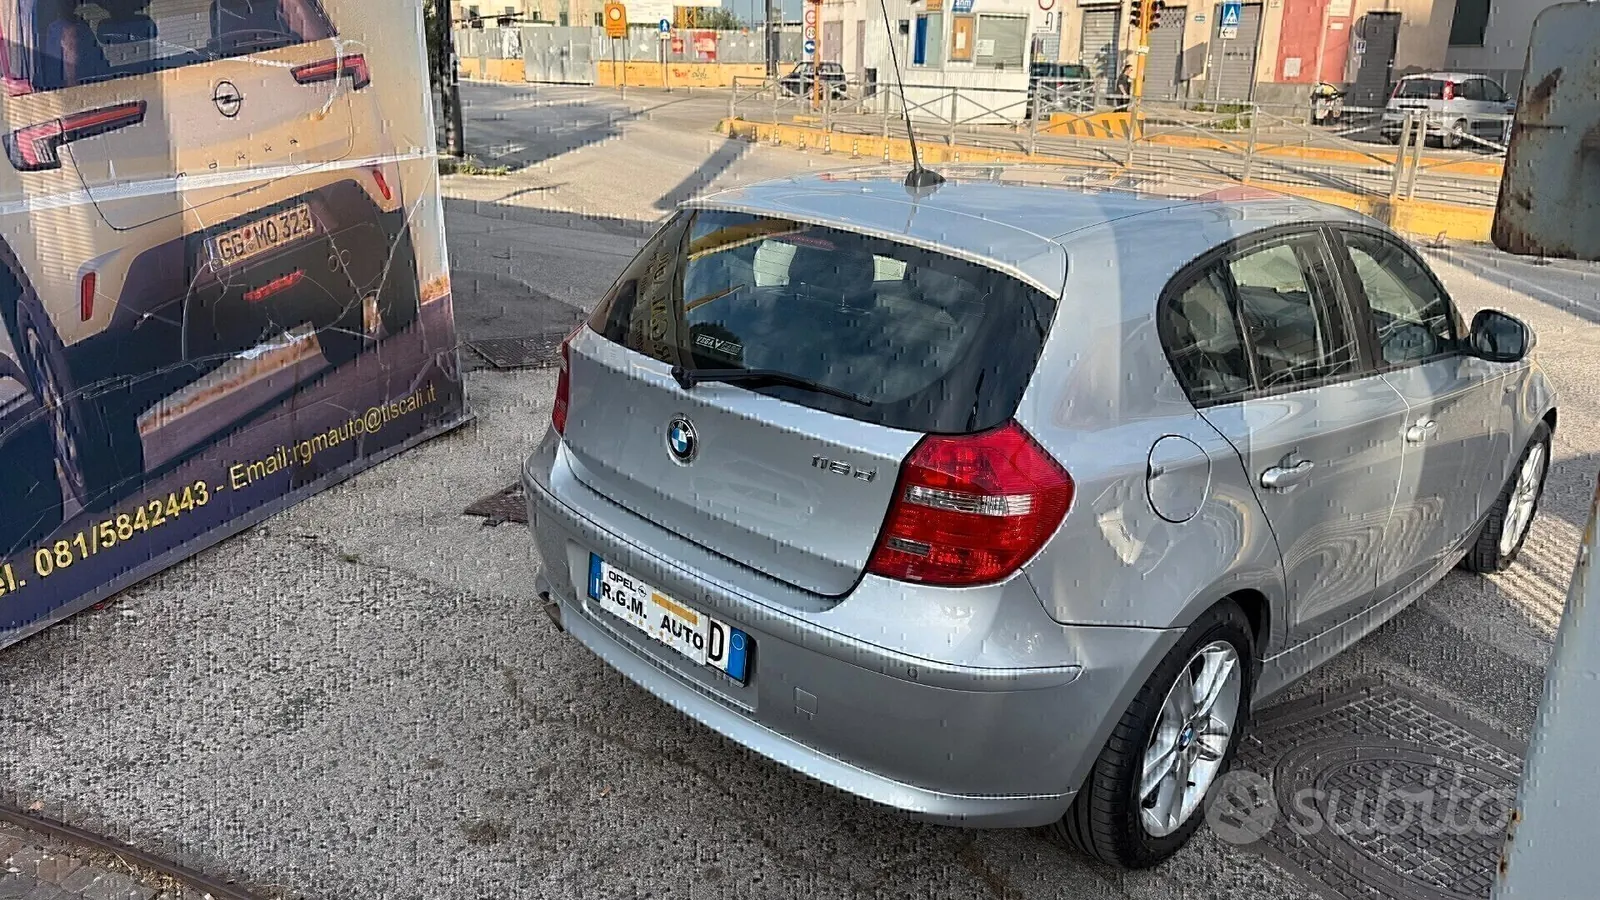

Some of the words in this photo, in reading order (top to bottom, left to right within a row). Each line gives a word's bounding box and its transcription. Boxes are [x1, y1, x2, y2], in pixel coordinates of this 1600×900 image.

[219, 233, 244, 260] GG
[279, 208, 311, 238] 323
[0, 563, 26, 597] l.
[34, 481, 210, 577] 081/5842443
[230, 384, 436, 491] Email:rgmauto@tiscali.it
[609, 571, 636, 592] OPEL
[602, 582, 647, 619] R.G.M.
[660, 615, 704, 651] AUTO
